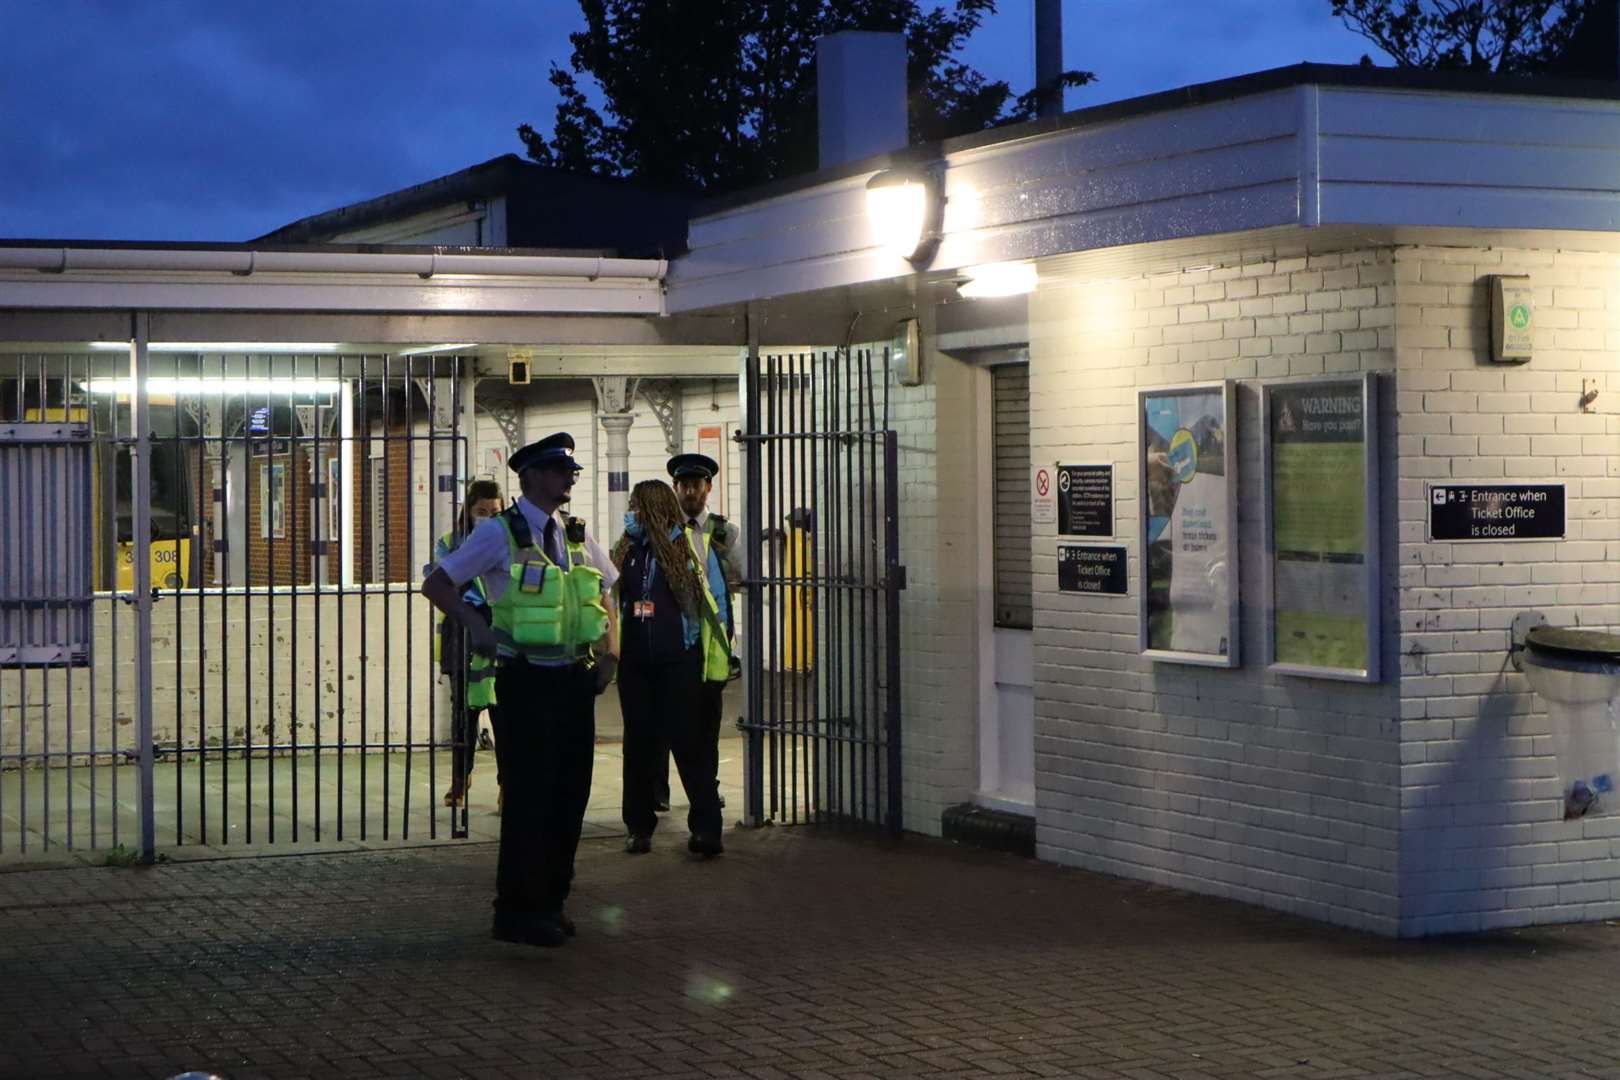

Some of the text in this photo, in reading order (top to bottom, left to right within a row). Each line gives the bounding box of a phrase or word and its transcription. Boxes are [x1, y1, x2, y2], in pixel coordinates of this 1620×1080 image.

[1302, 397, 1361, 414] WARNING
[1302, 419, 1322, 431] Have
[1323, 421, 1337, 432] you
[1471, 490, 1547, 502] Entrance when
[1471, 506, 1535, 519] Ticket Office
[1471, 524, 1515, 536] is closed
[154, 550, 177, 563] 308
[1077, 550, 1118, 561] Entrance when
[1077, 564, 1111, 576] Ticket Office
[1083, 580, 1101, 591] closed
